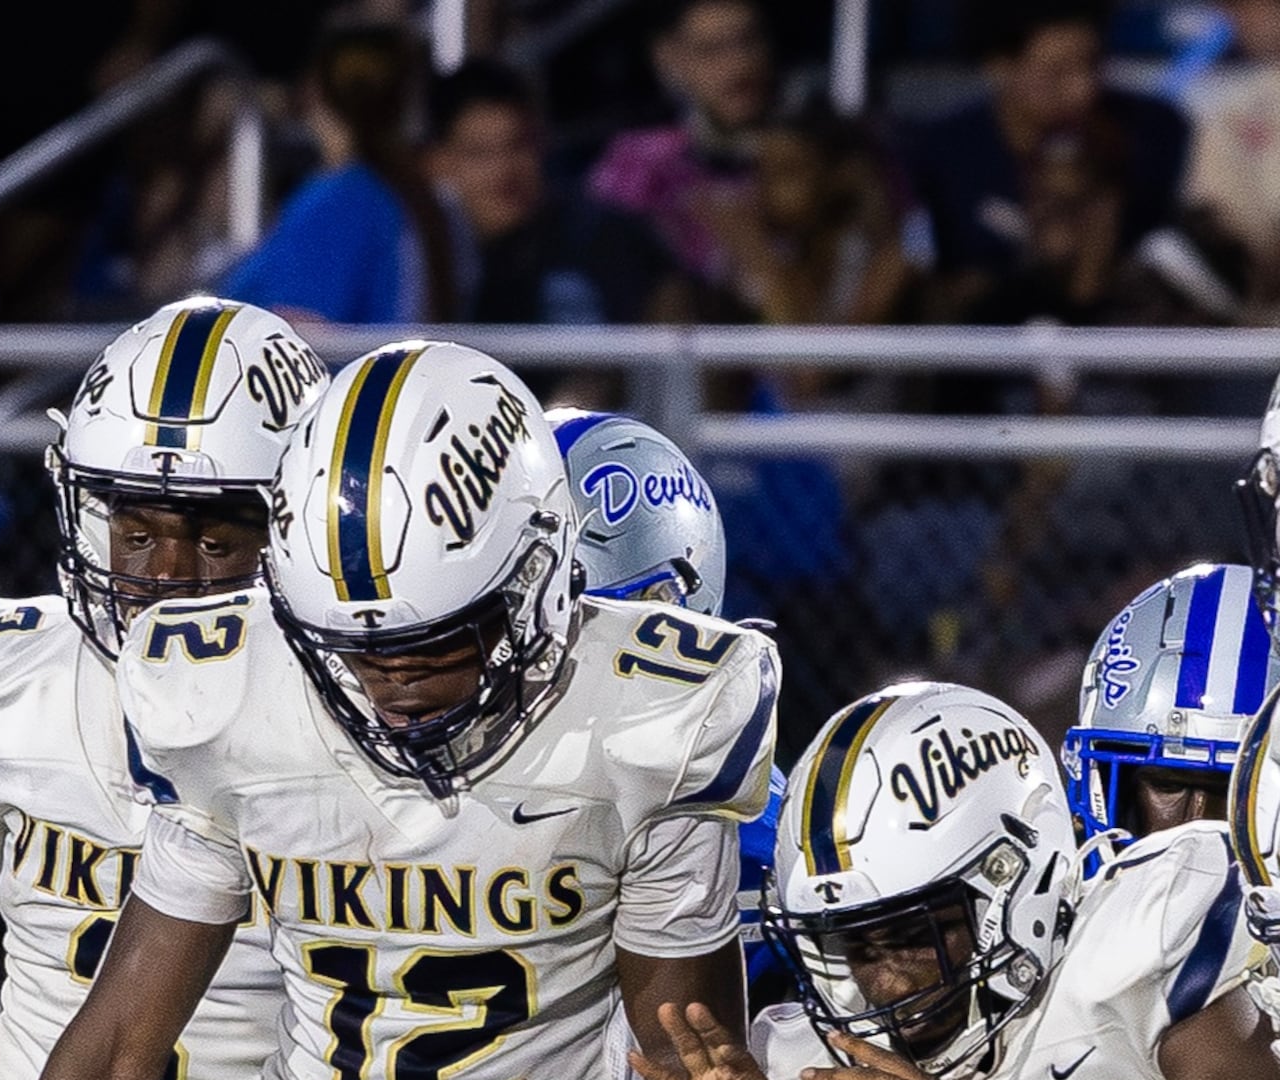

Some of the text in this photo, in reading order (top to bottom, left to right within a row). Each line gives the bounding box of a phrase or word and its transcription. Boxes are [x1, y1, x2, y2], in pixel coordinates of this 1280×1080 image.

[423, 392, 532, 551] Vikings
[580, 461, 713, 525] Devils
[613, 610, 743, 688] 12
[891, 725, 1041, 824] Vikings
[243, 842, 586, 938] VIKINGS
